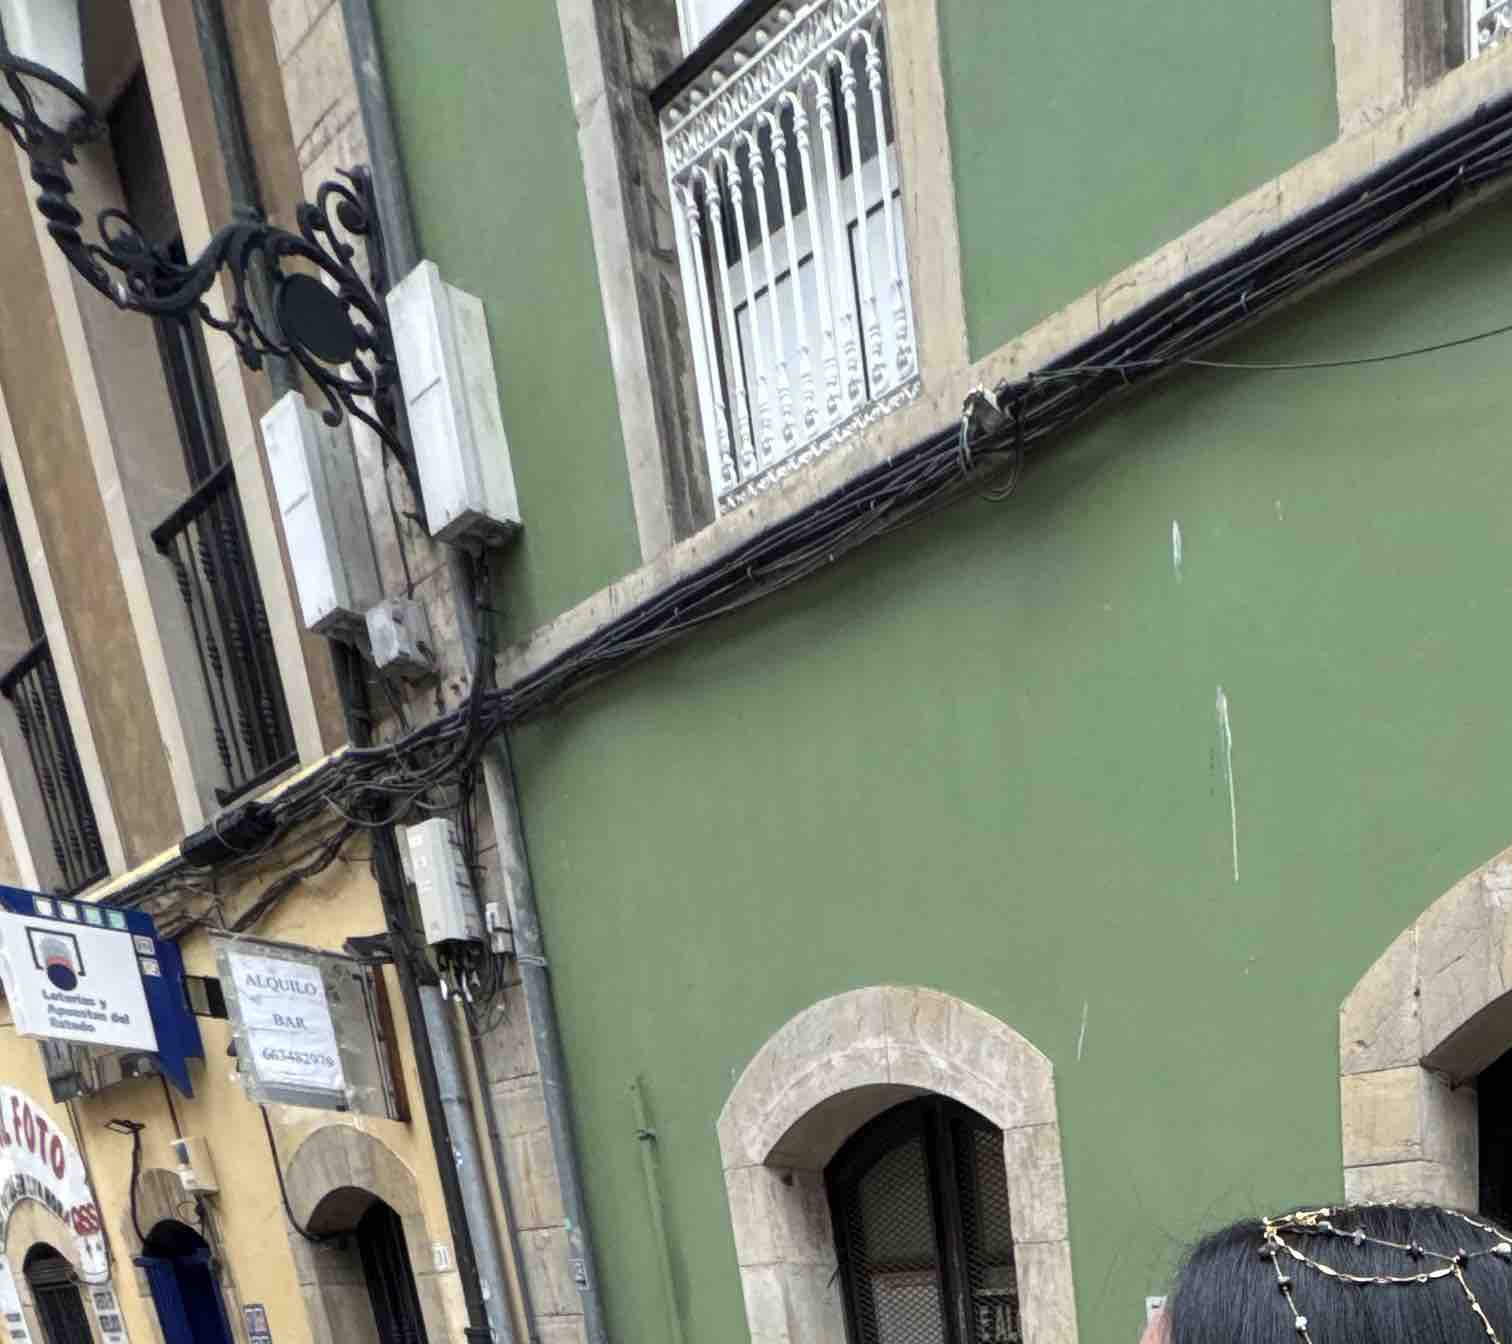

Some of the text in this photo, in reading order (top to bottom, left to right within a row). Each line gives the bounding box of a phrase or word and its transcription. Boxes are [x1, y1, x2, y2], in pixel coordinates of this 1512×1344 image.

[246, 973, 317, 996] ALQUILO
[272, 1014, 309, 1031] BAR
[11, 1095, 66, 1181] FOTO
